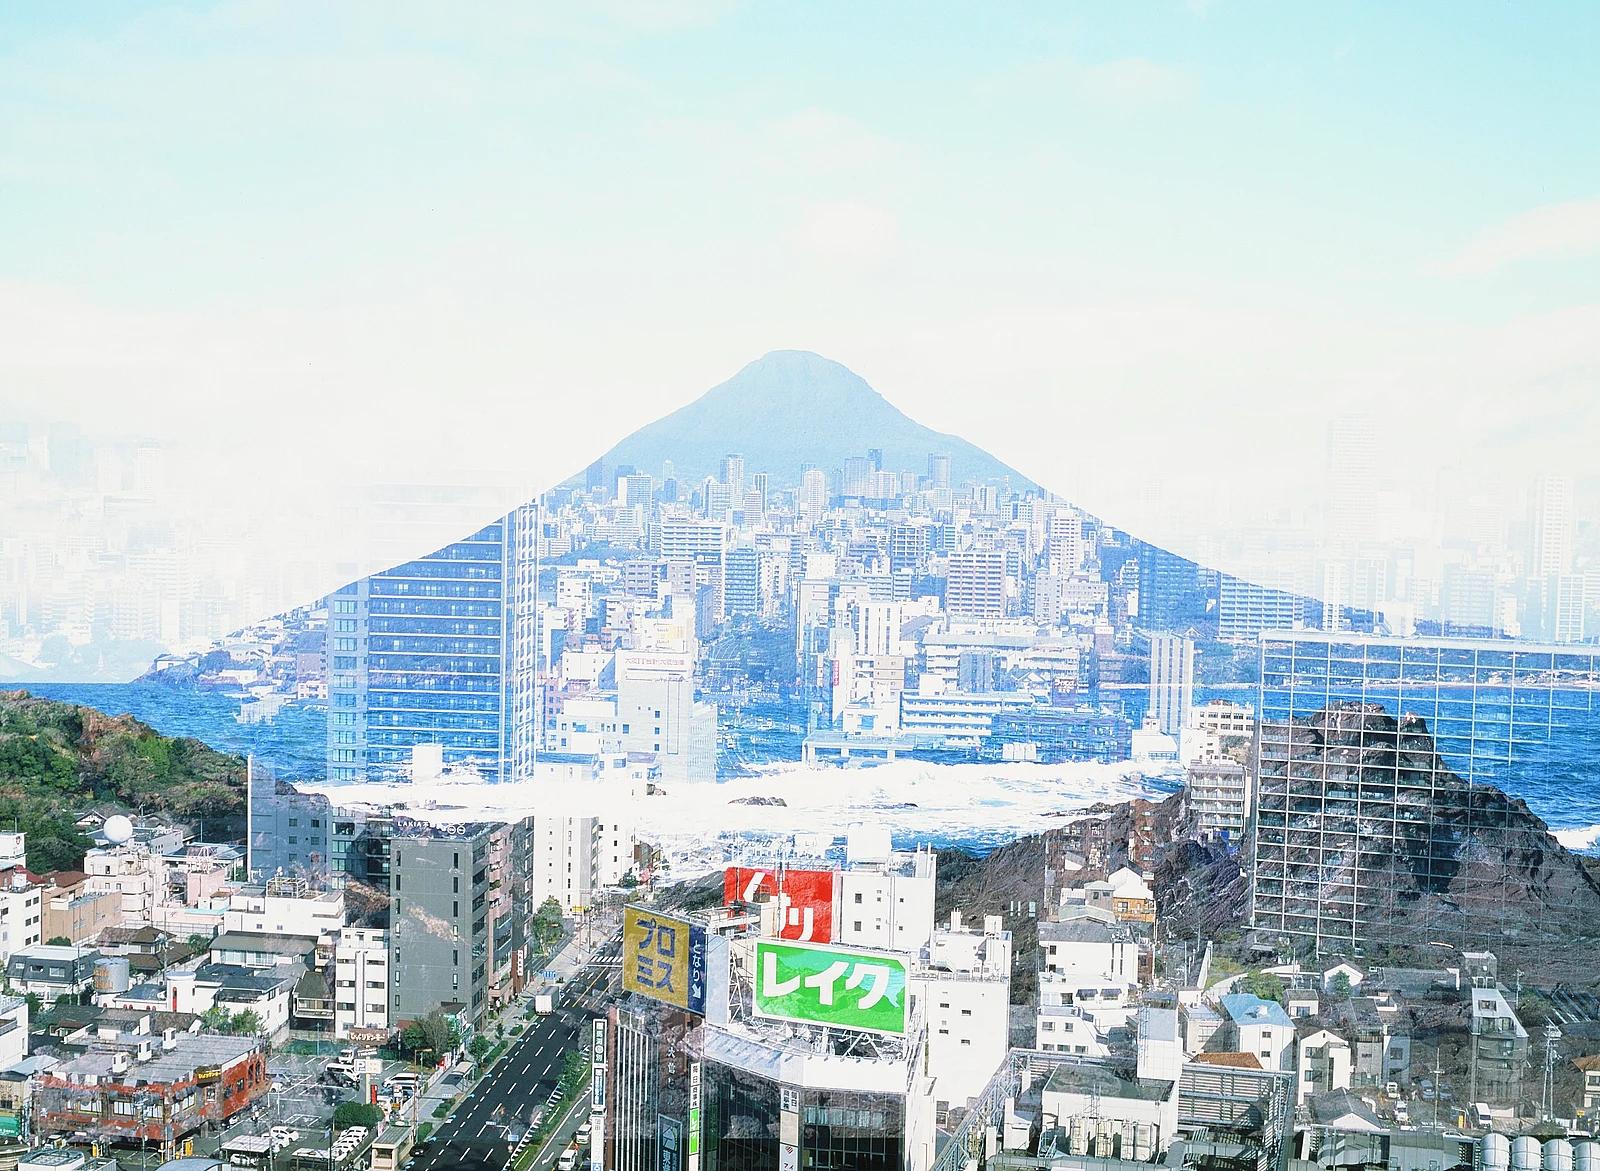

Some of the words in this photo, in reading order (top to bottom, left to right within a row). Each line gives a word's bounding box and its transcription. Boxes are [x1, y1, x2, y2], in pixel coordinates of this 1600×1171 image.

[636, 917, 676, 958] プロ
[636, 954, 675, 994] ミス
[692, 939, 702, 982] となり
[762, 951, 891, 1010] レイク
